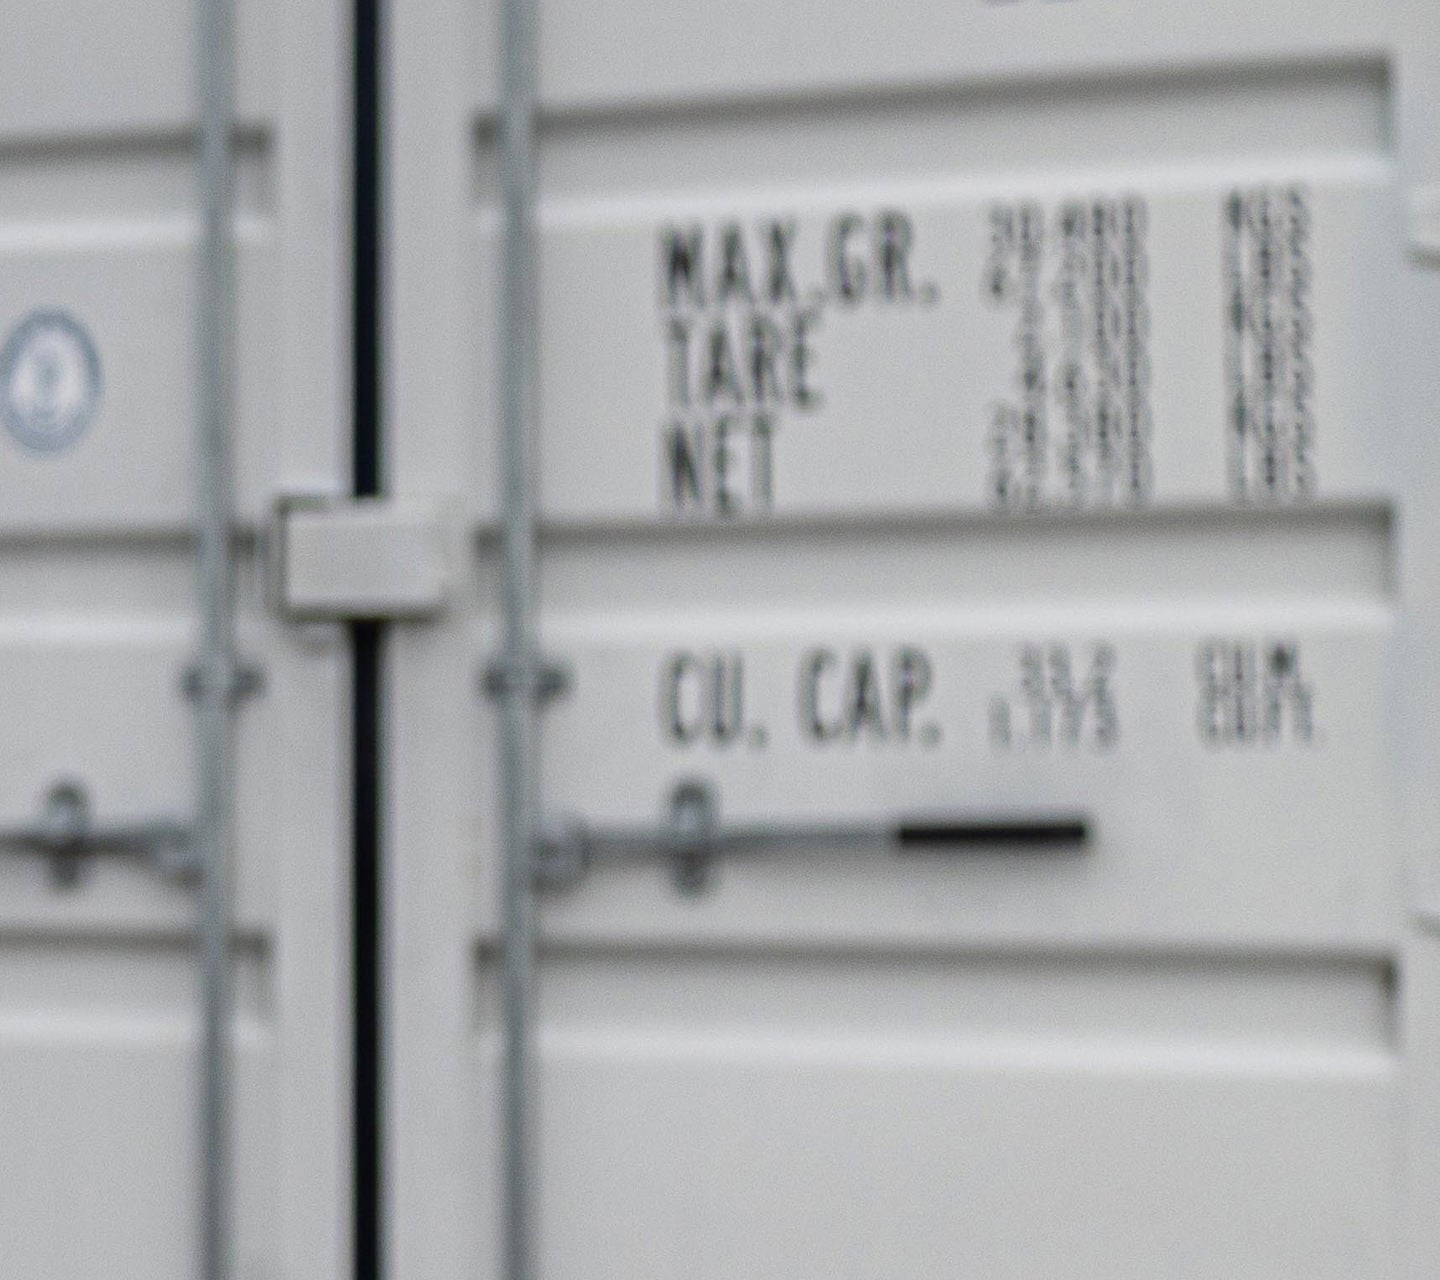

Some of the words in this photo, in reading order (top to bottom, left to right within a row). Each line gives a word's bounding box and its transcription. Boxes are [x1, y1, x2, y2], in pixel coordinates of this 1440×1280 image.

[665, 308, 822, 412] TARE
[660, 412, 776, 516] NET
[658, 647, 768, 752] CU.
[800, 643, 944, 752] CAP.
